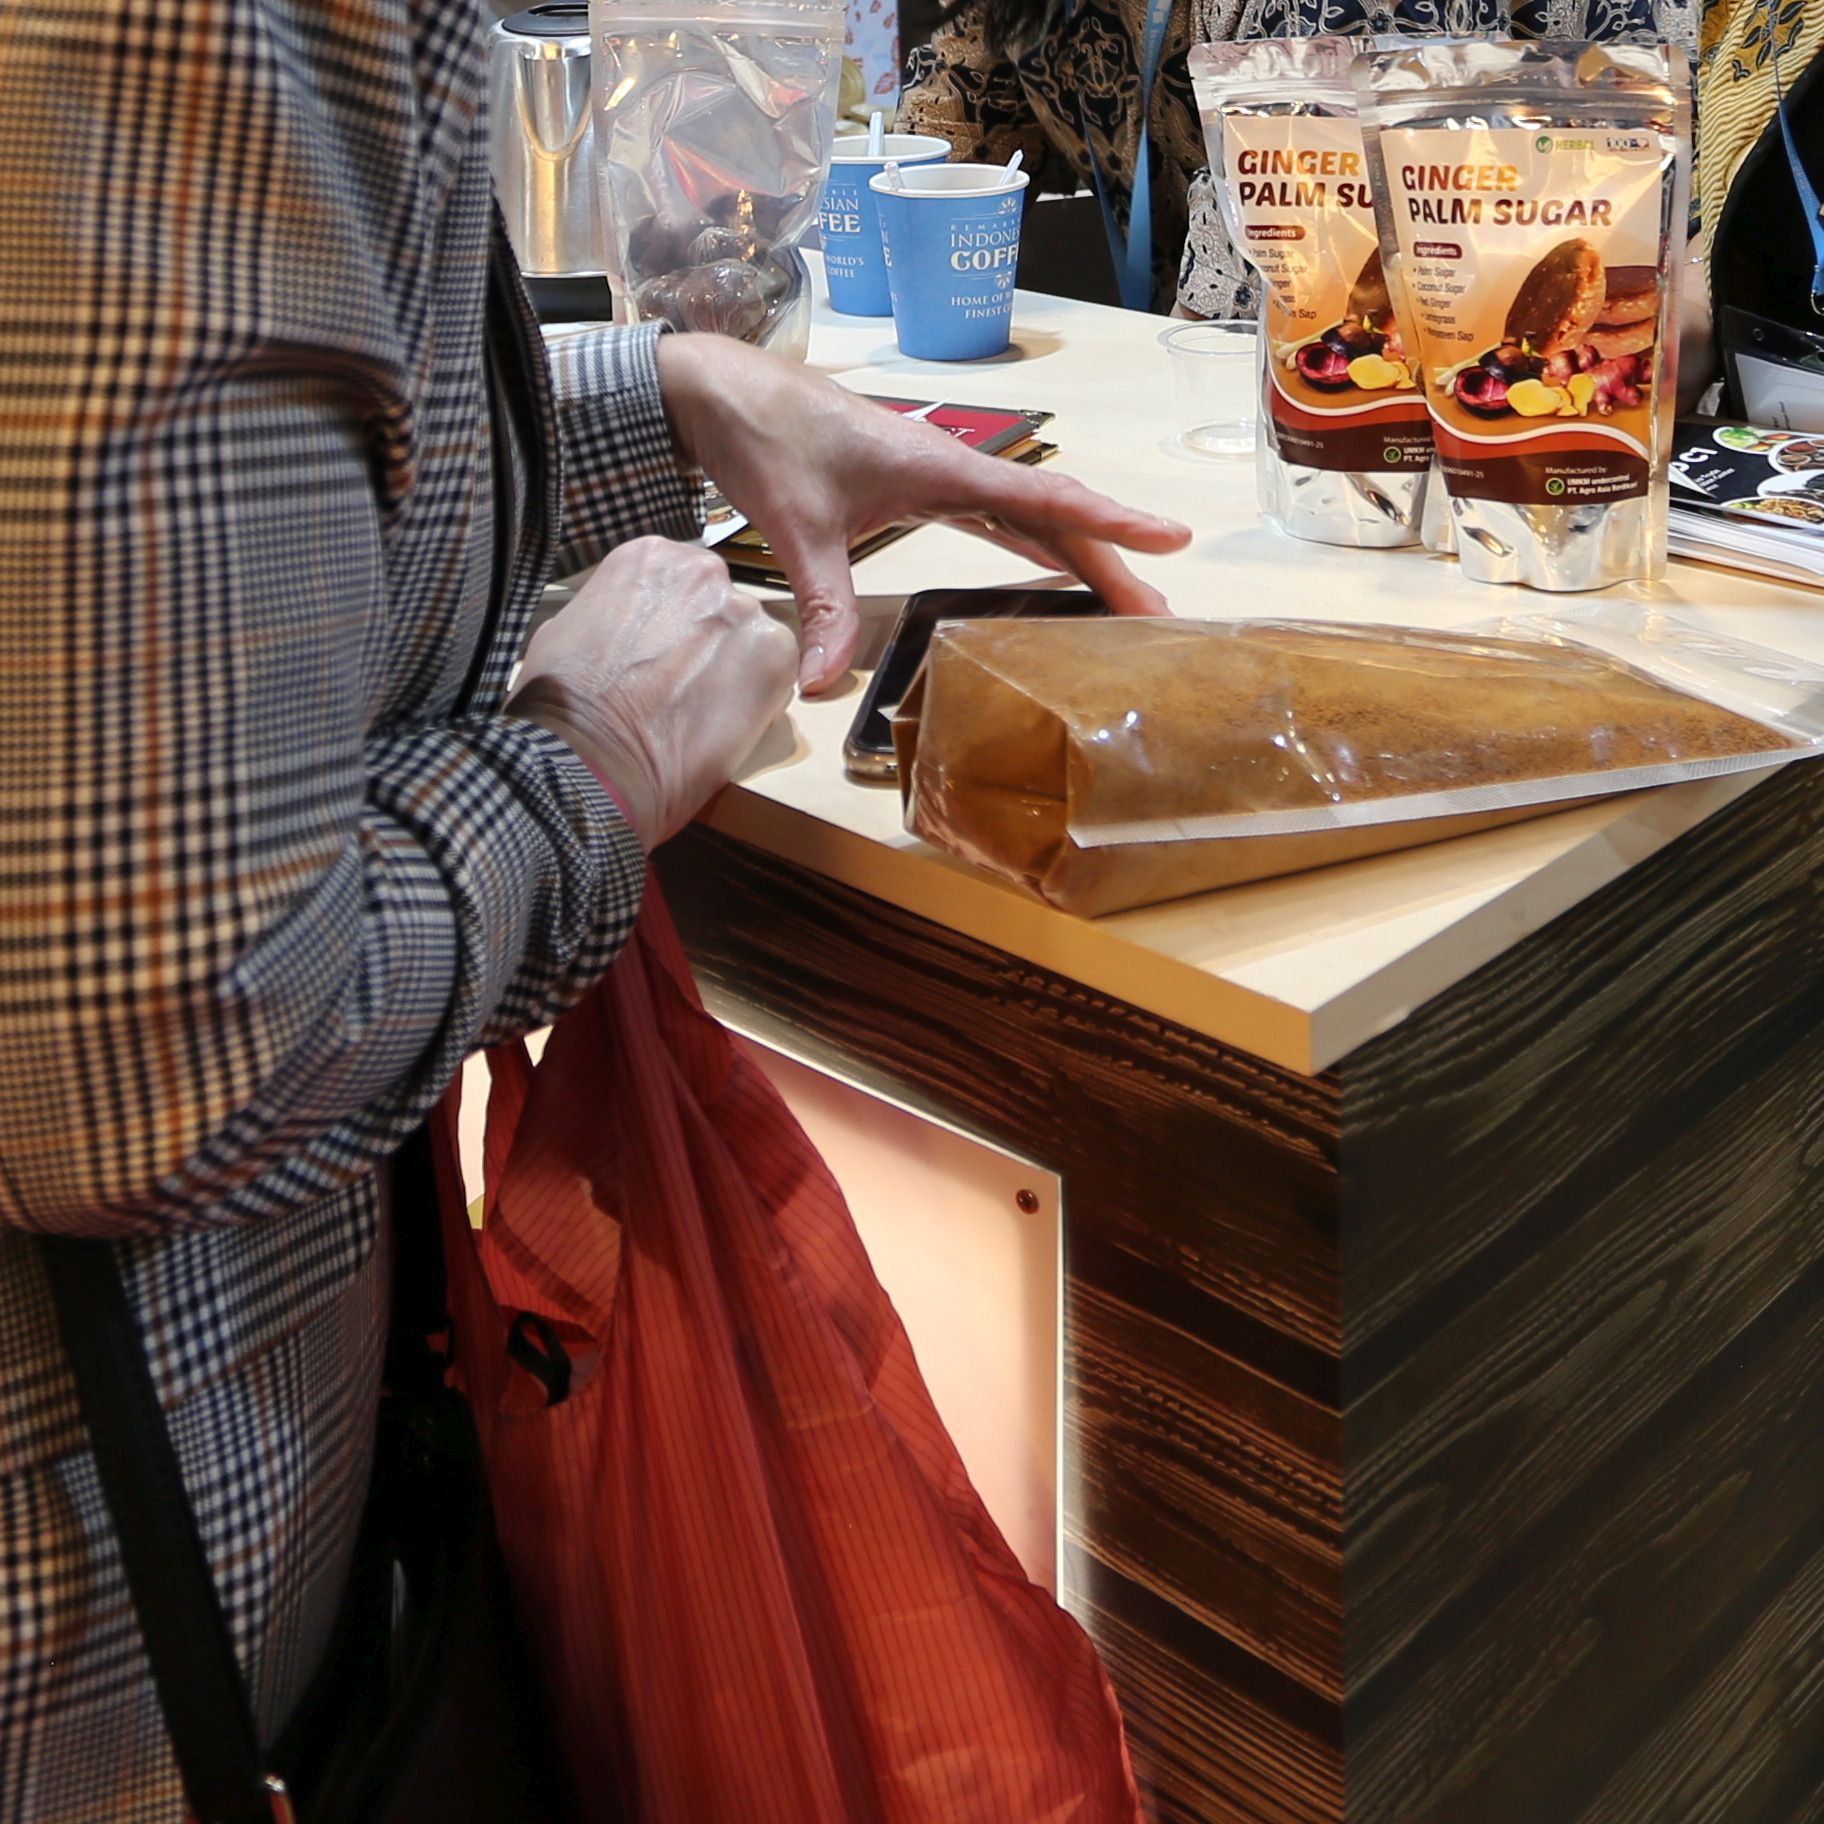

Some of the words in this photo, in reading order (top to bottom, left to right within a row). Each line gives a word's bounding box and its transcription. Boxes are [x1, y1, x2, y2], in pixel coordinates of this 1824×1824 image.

[1238, 150, 1360, 176] GINGER
[1402, 165, 1519, 192] GINGER
[1239, 182, 1326, 207] PALM
[1337, 184, 1374, 208] SU
[819, 212, 861, 232] FEE
[1409, 198, 1481, 225] PALM
[1493, 199, 1612, 226] SUGAR
[951, 228, 1020, 247] INDONE
[951, 242, 1018, 271] COFF
[951, 295, 988, 306] HOME
